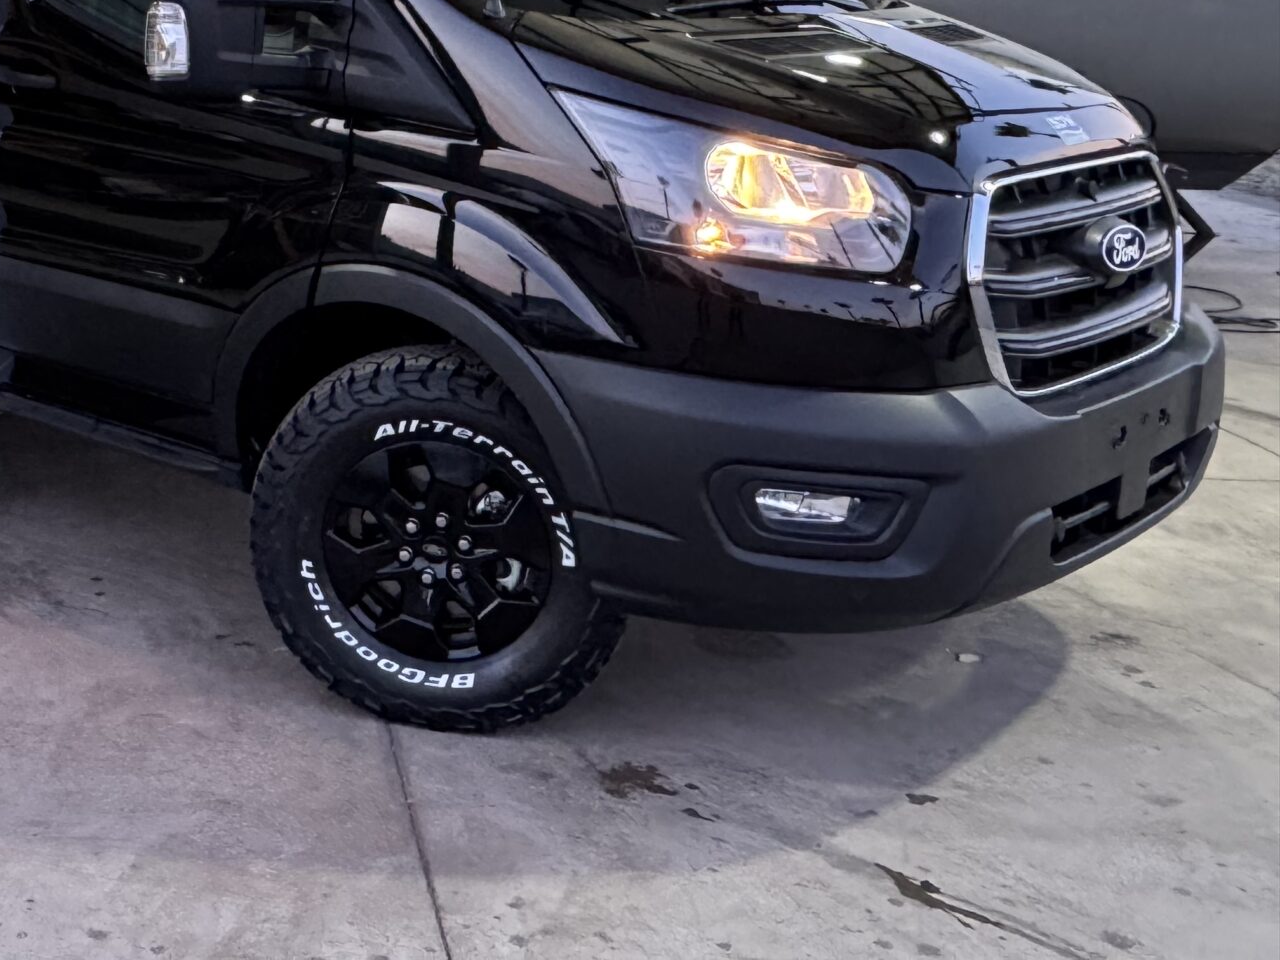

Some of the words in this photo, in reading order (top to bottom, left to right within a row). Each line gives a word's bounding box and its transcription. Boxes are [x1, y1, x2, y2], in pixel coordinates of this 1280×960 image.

[1112, 232, 1140, 265] Ford
[373, 419, 556, 506] All-Terrain
[550, 512, 577, 568] T/A
[300, 558, 476, 690] BFGoodrich
